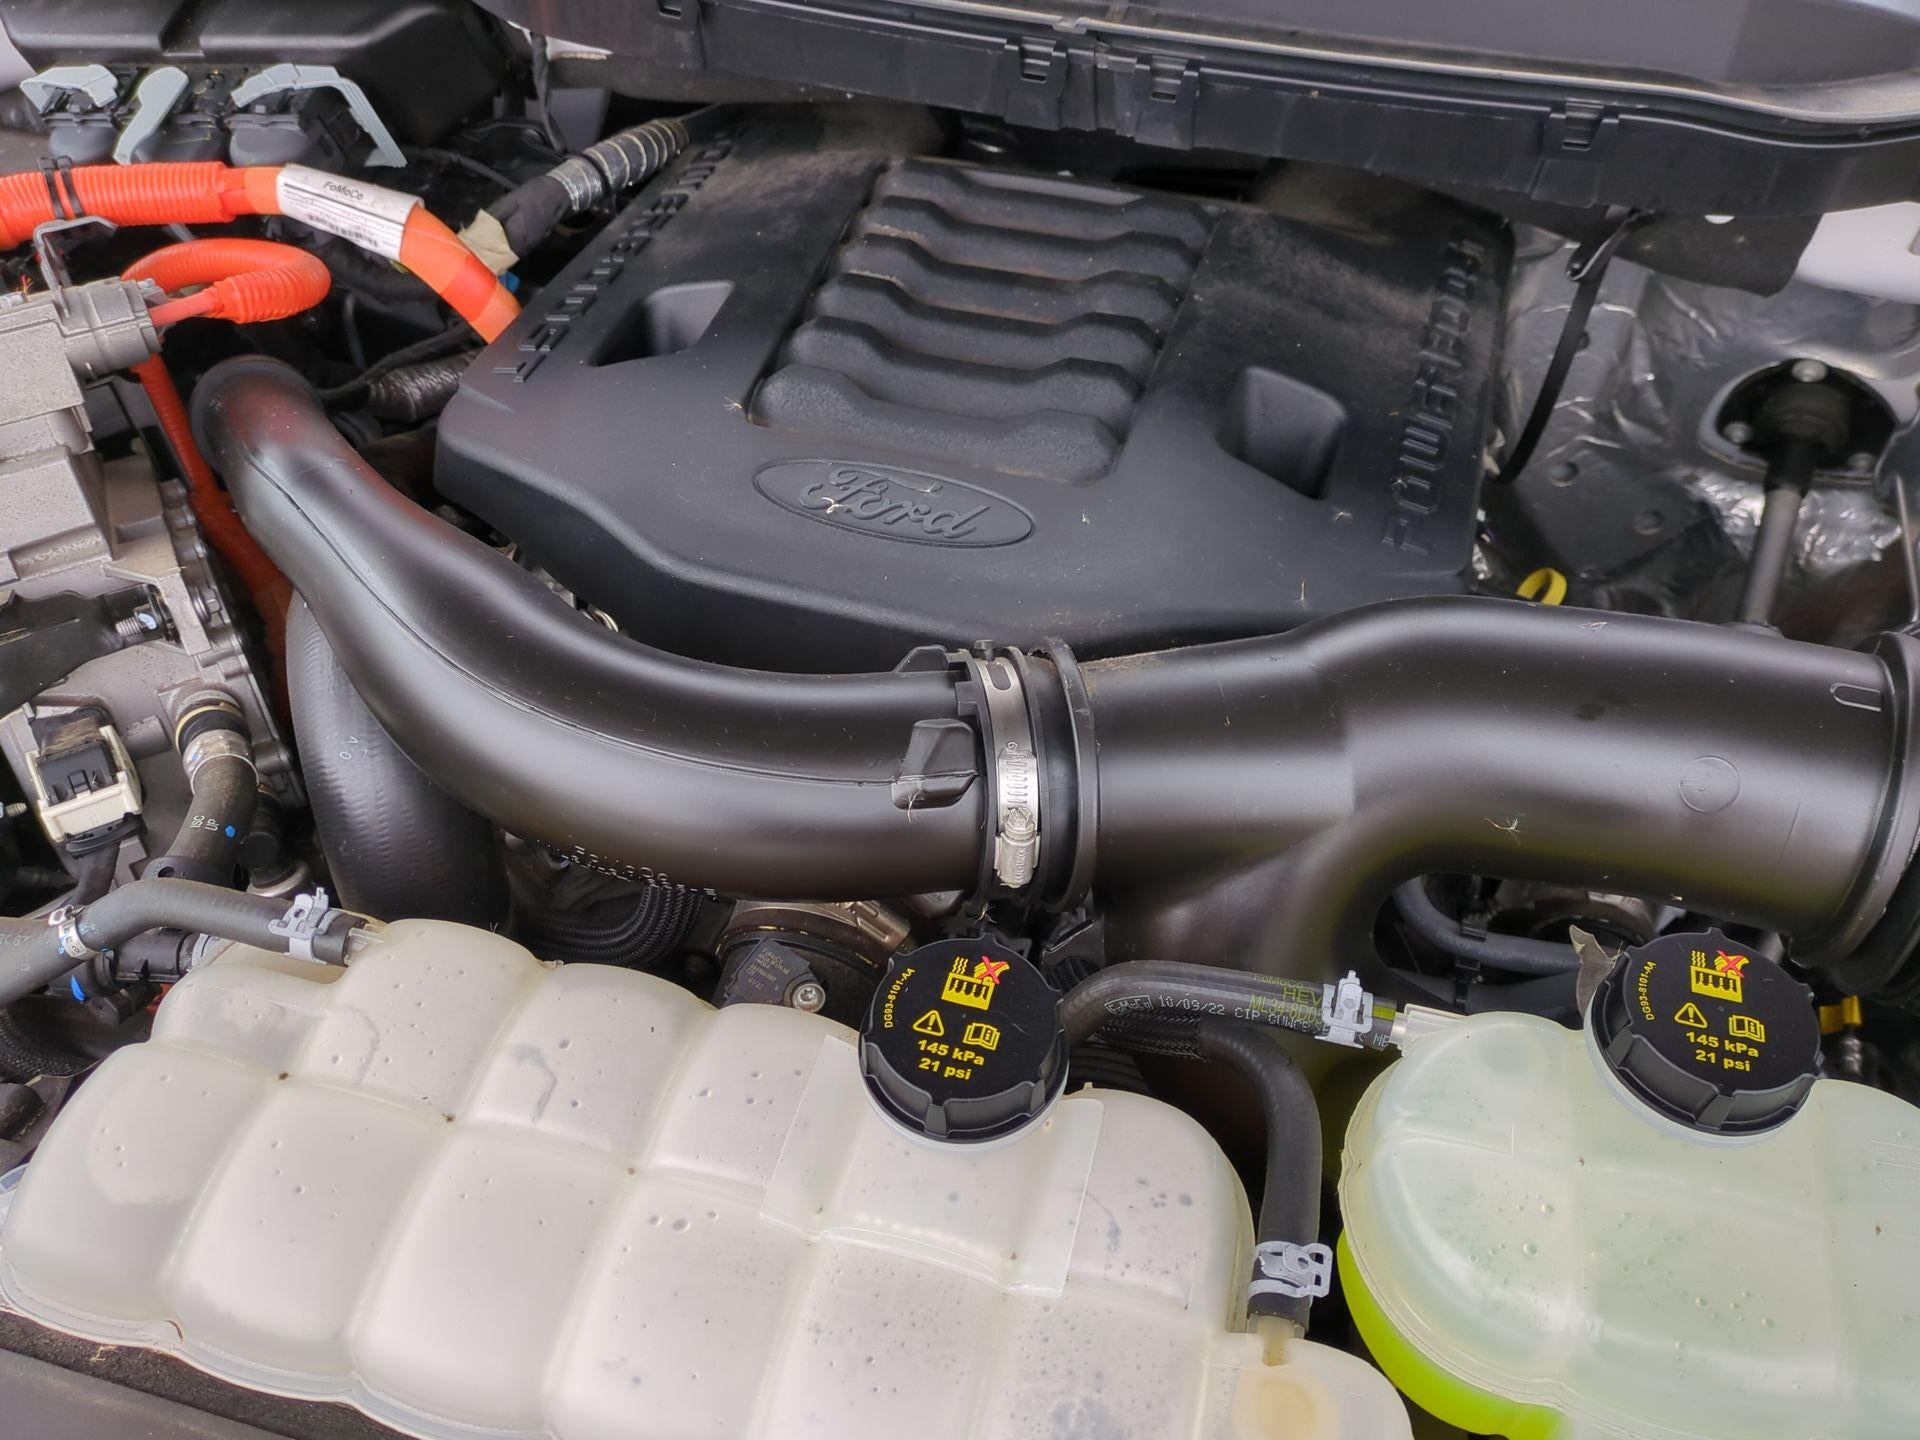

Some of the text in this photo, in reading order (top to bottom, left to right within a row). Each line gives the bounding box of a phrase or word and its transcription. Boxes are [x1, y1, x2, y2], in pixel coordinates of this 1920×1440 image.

[800, 468, 990, 538] Ford
[884, 968, 916, 1028] DG93-8101-AA
[1283, 986, 1322, 1006] HEV
[1638, 961, 1657, 1021] DG93-8101-AA
[917, 1039, 985, 1065] 145 kPa
[1686, 1032, 1759, 1057] 145 kPa
[918, 1057, 972, 1080] 21 psi
[1695, 1050, 1751, 1072] 21 psi
